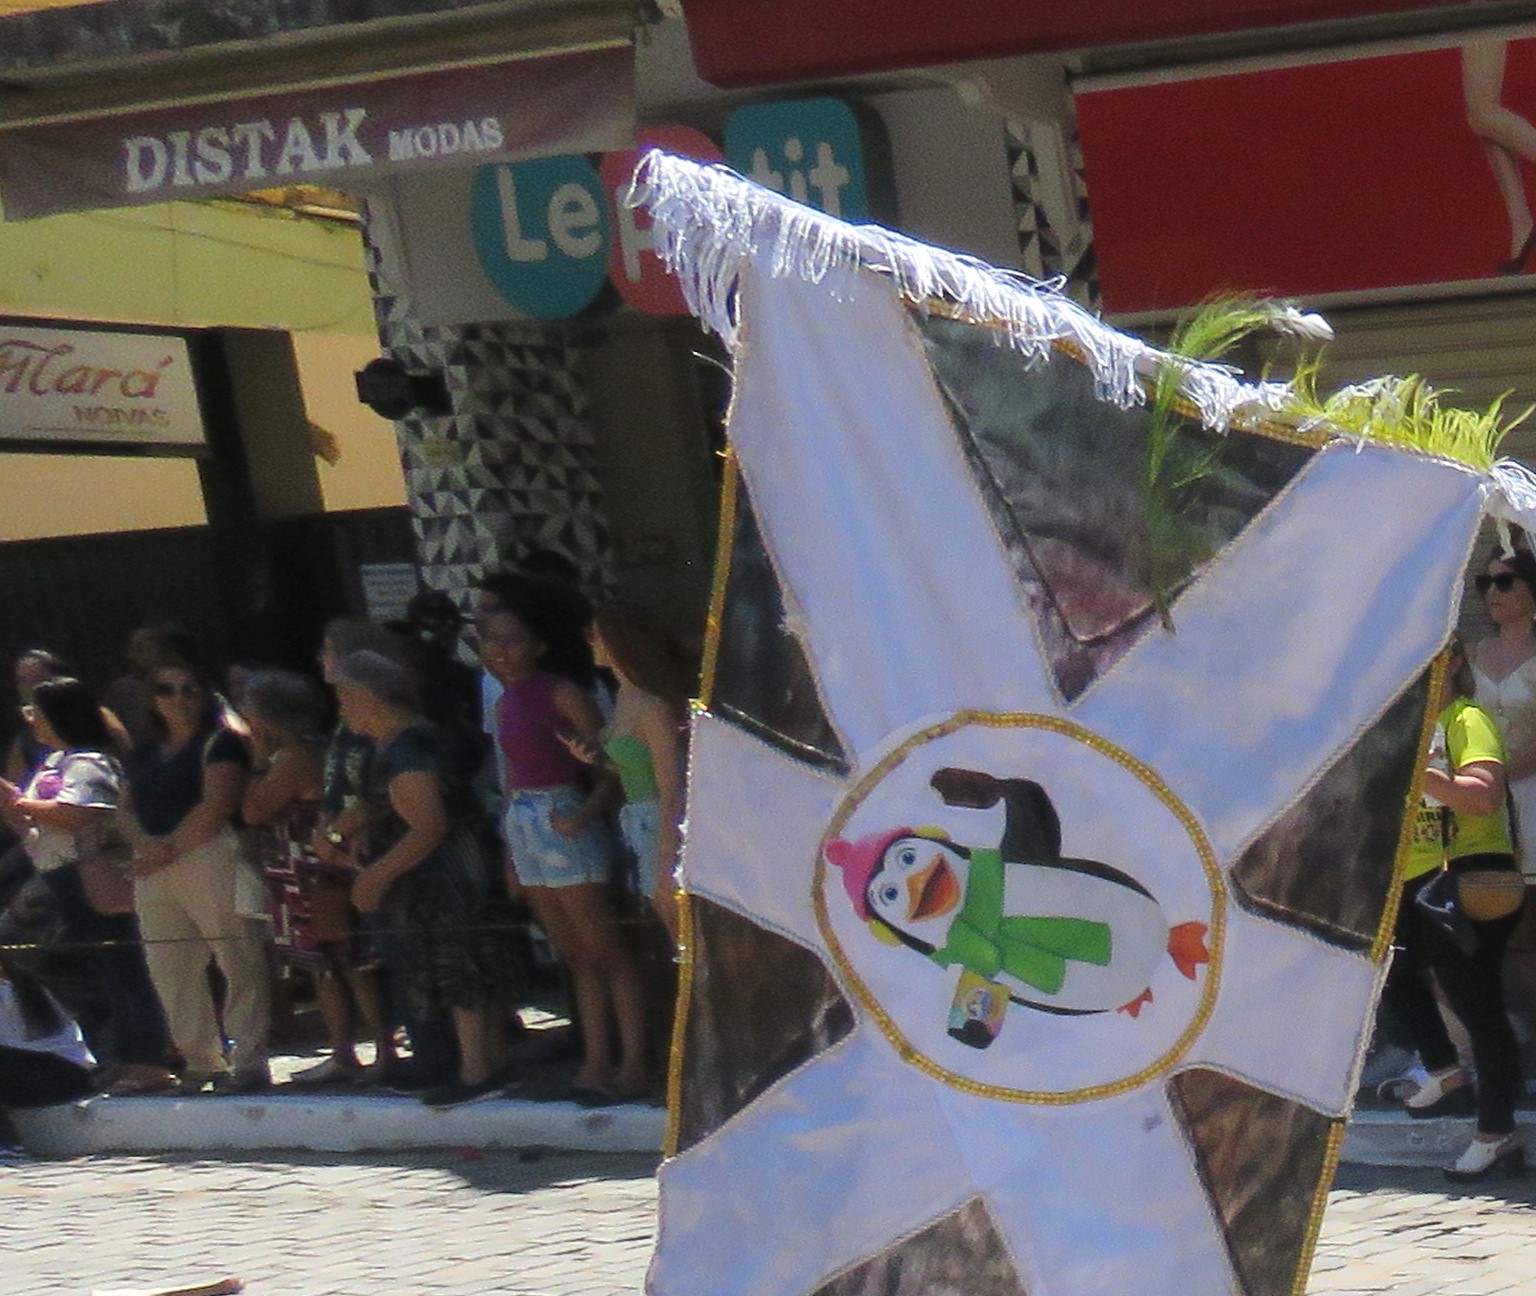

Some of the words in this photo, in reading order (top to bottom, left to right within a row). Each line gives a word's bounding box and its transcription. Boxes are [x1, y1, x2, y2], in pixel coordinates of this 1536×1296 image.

[122, 106, 374, 193] DISTAK
[387, 116, 504, 163] MODAS
[498, 163, 603, 263] Le
